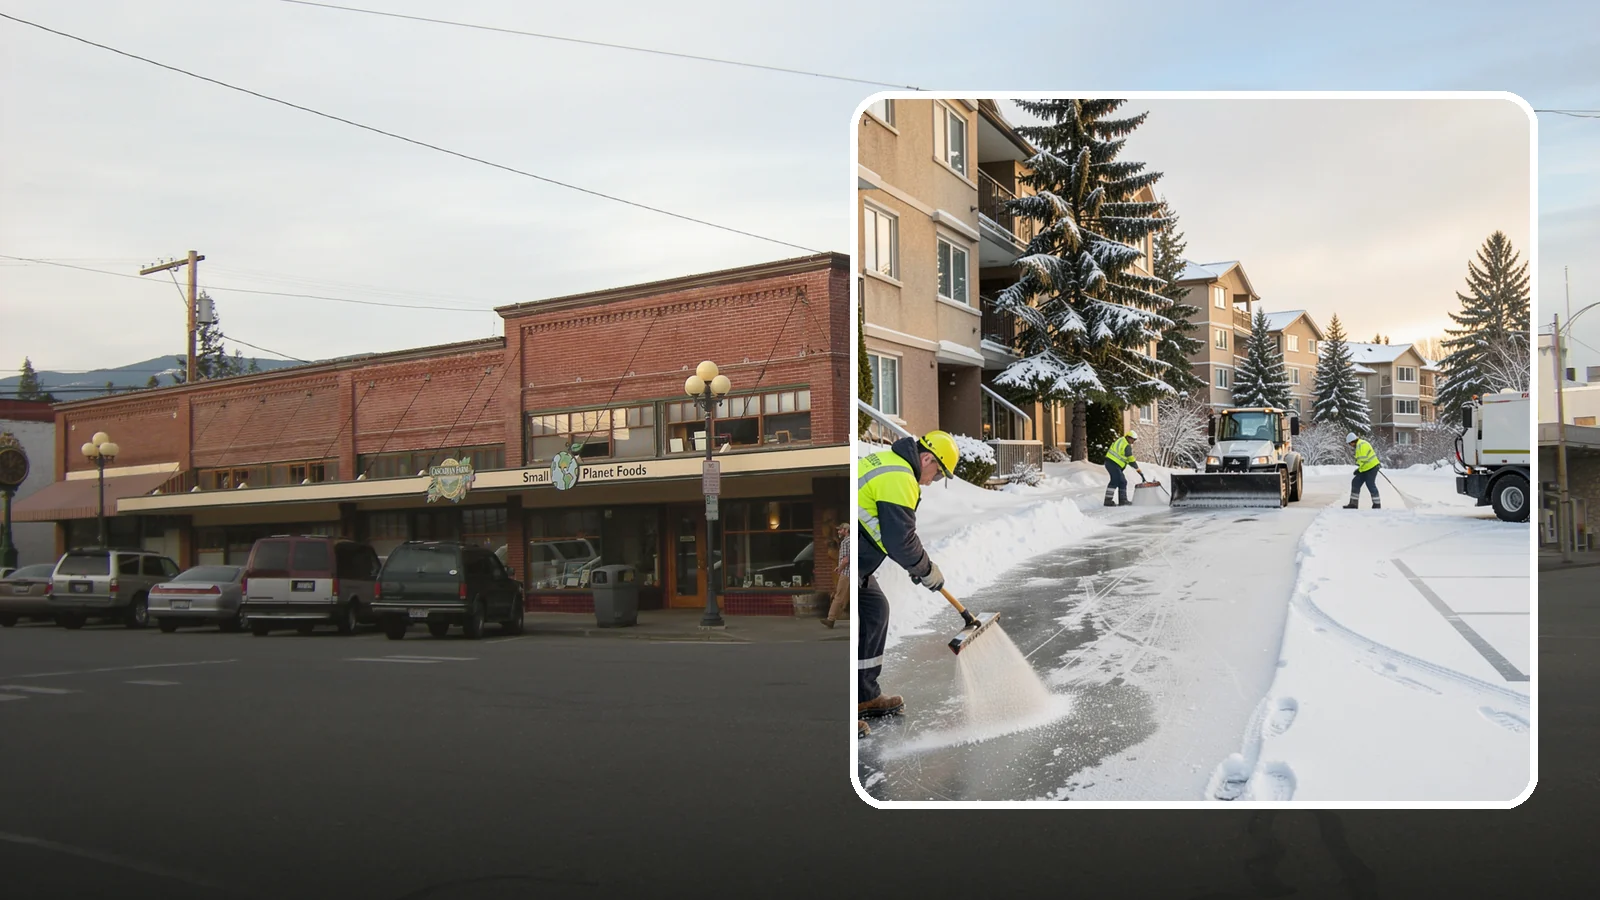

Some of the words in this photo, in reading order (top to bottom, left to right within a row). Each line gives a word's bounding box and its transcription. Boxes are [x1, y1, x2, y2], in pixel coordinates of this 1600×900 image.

[523, 472, 549, 483] Small
[583, 468, 614, 479] Planet
[617, 465, 647, 476] Foods
